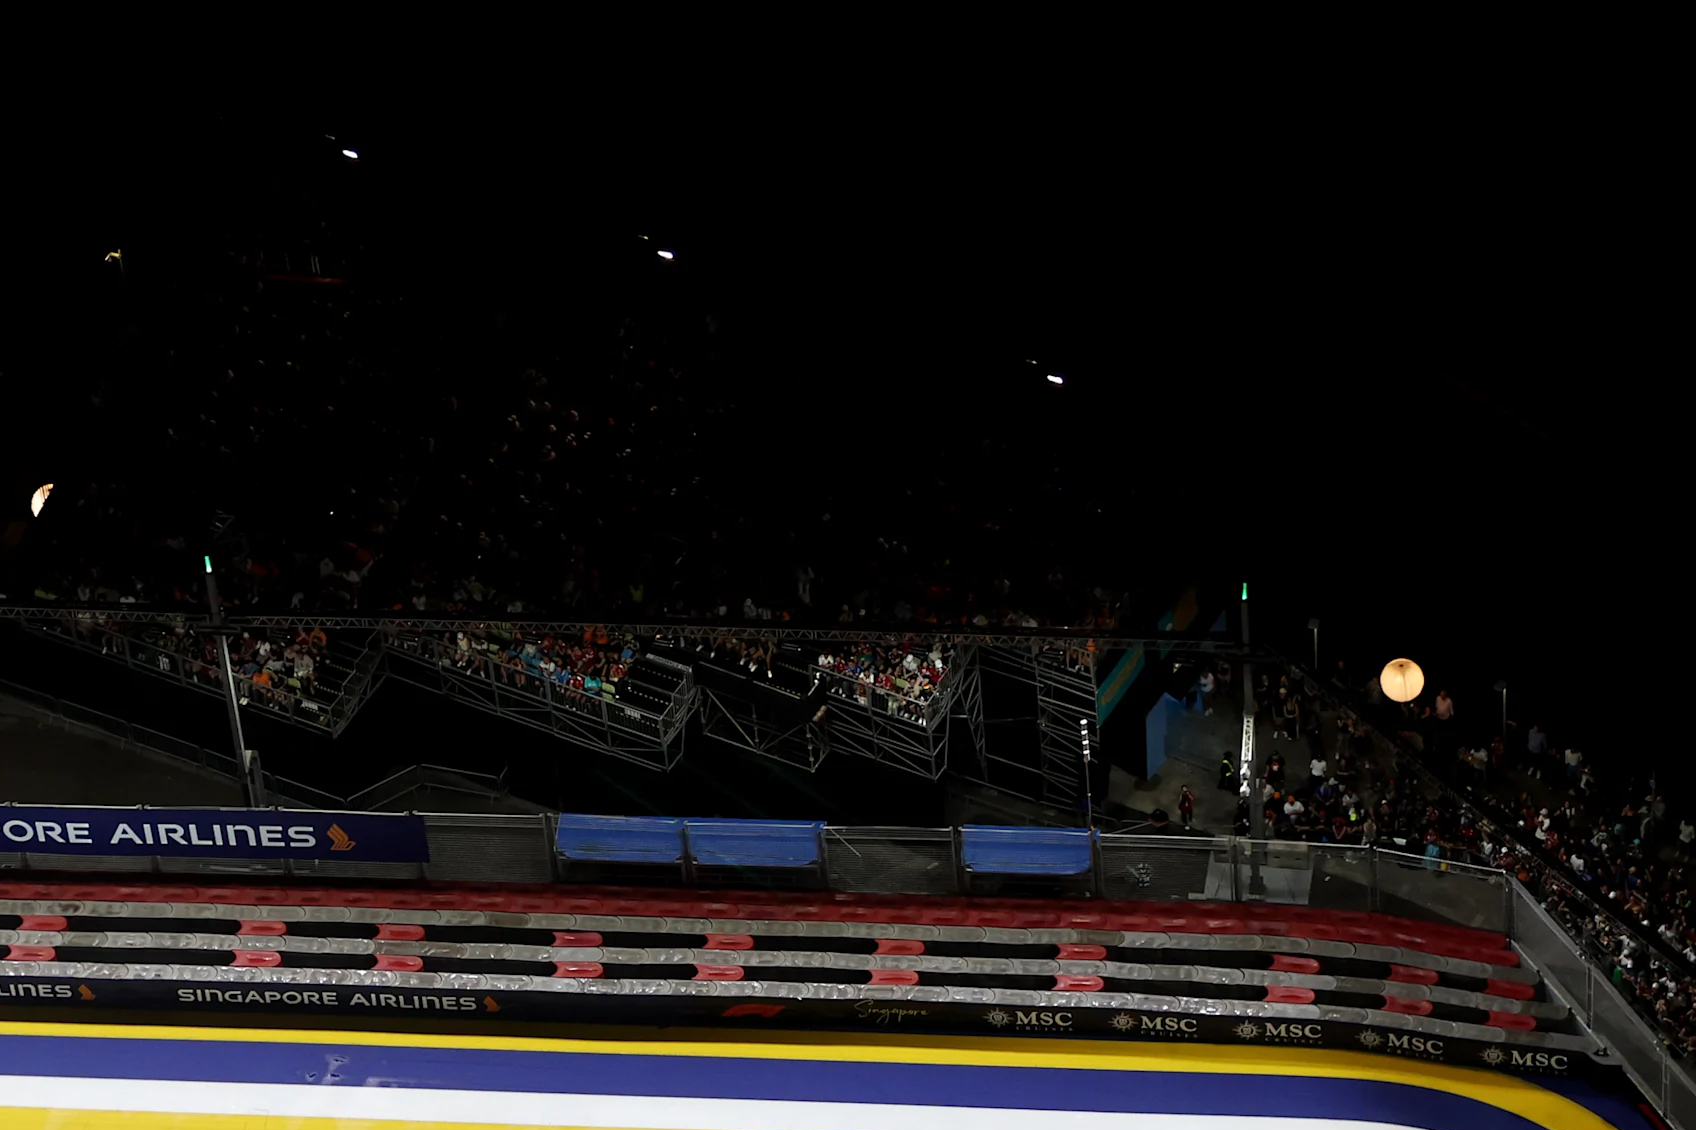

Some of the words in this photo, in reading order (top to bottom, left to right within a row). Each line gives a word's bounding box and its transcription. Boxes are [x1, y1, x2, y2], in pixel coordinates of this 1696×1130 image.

[110, 823, 316, 848] AIRLINES
[177, 988, 339, 1005] SINGAPORE
[349, 993, 477, 1011] AIRLINES
[1015, 1011, 1073, 1026] MSC
[1140, 1015, 1197, 1032] MSC
[1264, 1022, 1322, 1038] MSC
[1387, 1033, 1444, 1054] MSC
[1511, 1050, 1568, 1070] MSC
